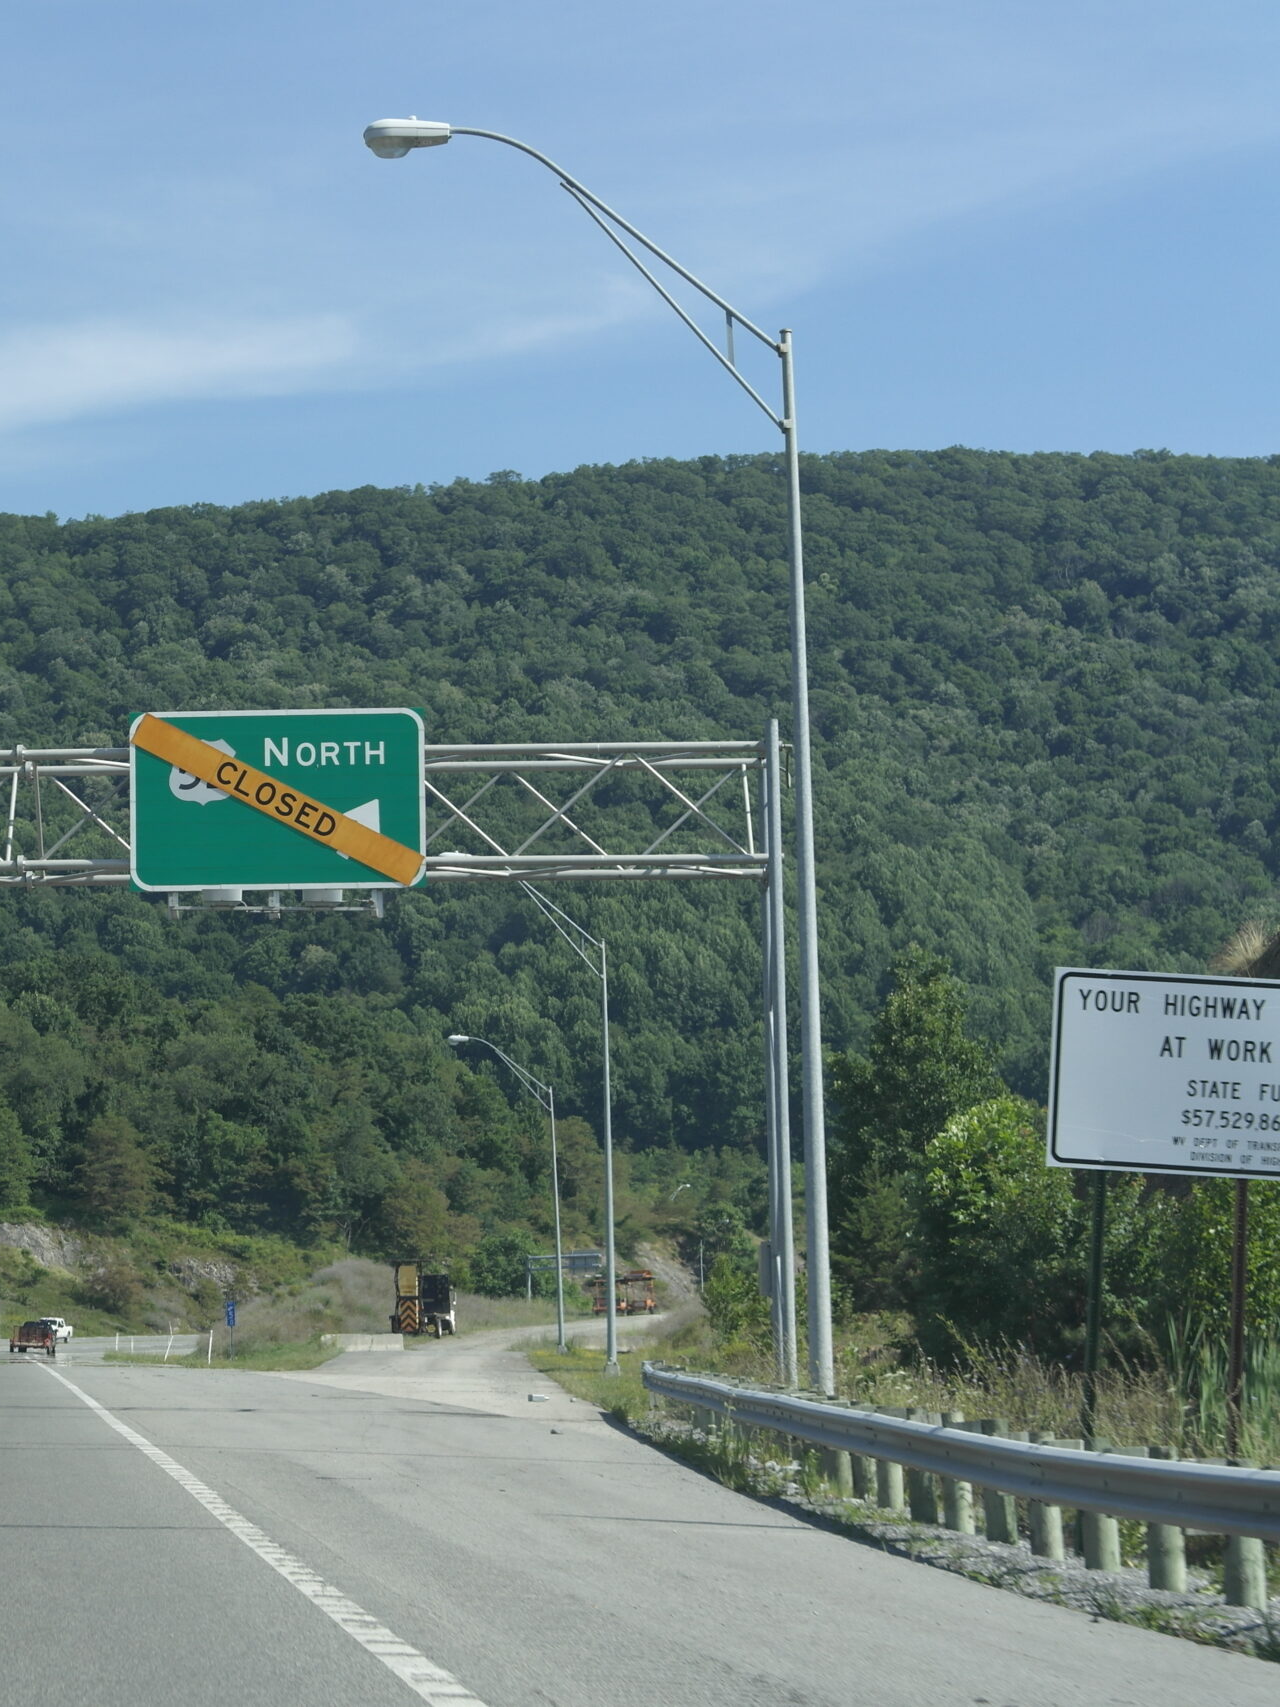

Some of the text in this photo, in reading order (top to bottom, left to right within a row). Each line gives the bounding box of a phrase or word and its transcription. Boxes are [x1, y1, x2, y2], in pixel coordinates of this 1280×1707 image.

[264, 737, 385, 767] NORTH
[216, 761, 337, 837] CLOSED
[1078, 988, 1266, 1021] YOUR HIGHWAY
[1160, 1035, 1273, 1064] AT WORK
[1186, 1079, 1242, 1100] STATE
[1225, 1139, 1239, 1149] OF
[1240, 1154, 1254, 1165] OF
